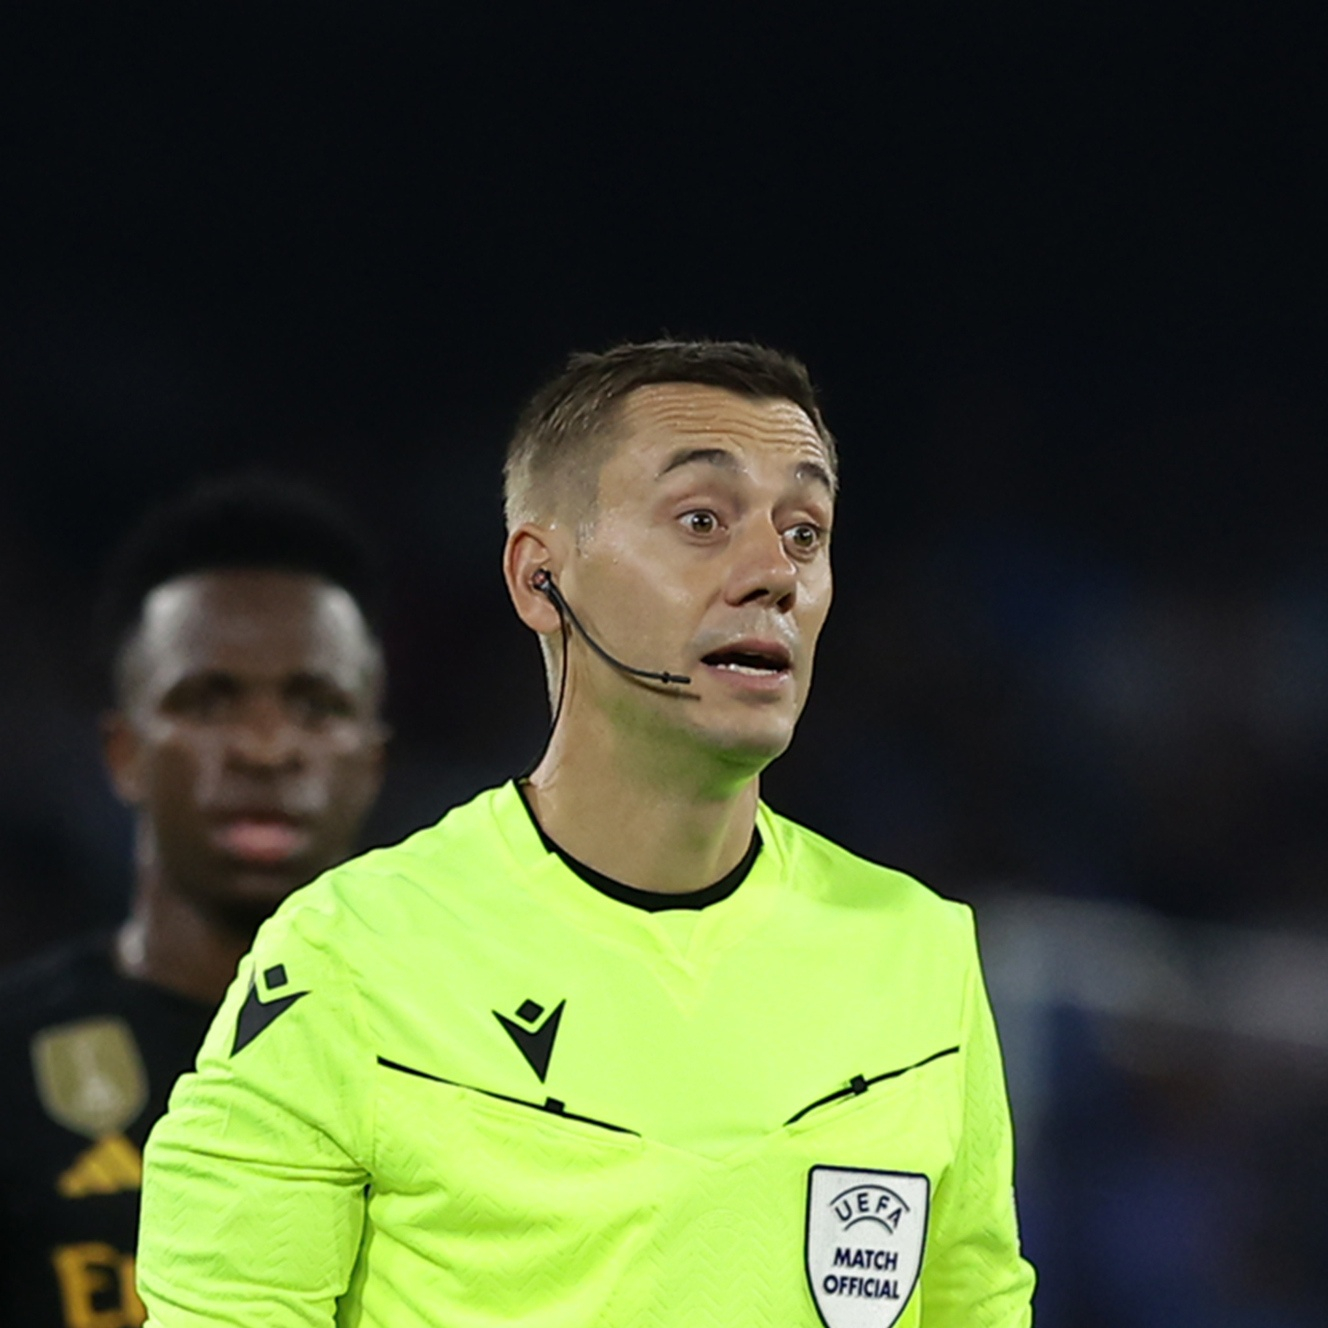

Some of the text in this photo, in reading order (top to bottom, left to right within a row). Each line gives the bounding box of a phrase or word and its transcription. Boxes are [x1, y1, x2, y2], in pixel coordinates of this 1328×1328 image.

[834, 1192, 903, 1229] UEFA
[833, 1247, 898, 1271] MATCH
[823, 1274, 901, 1300] OFFICIAL
